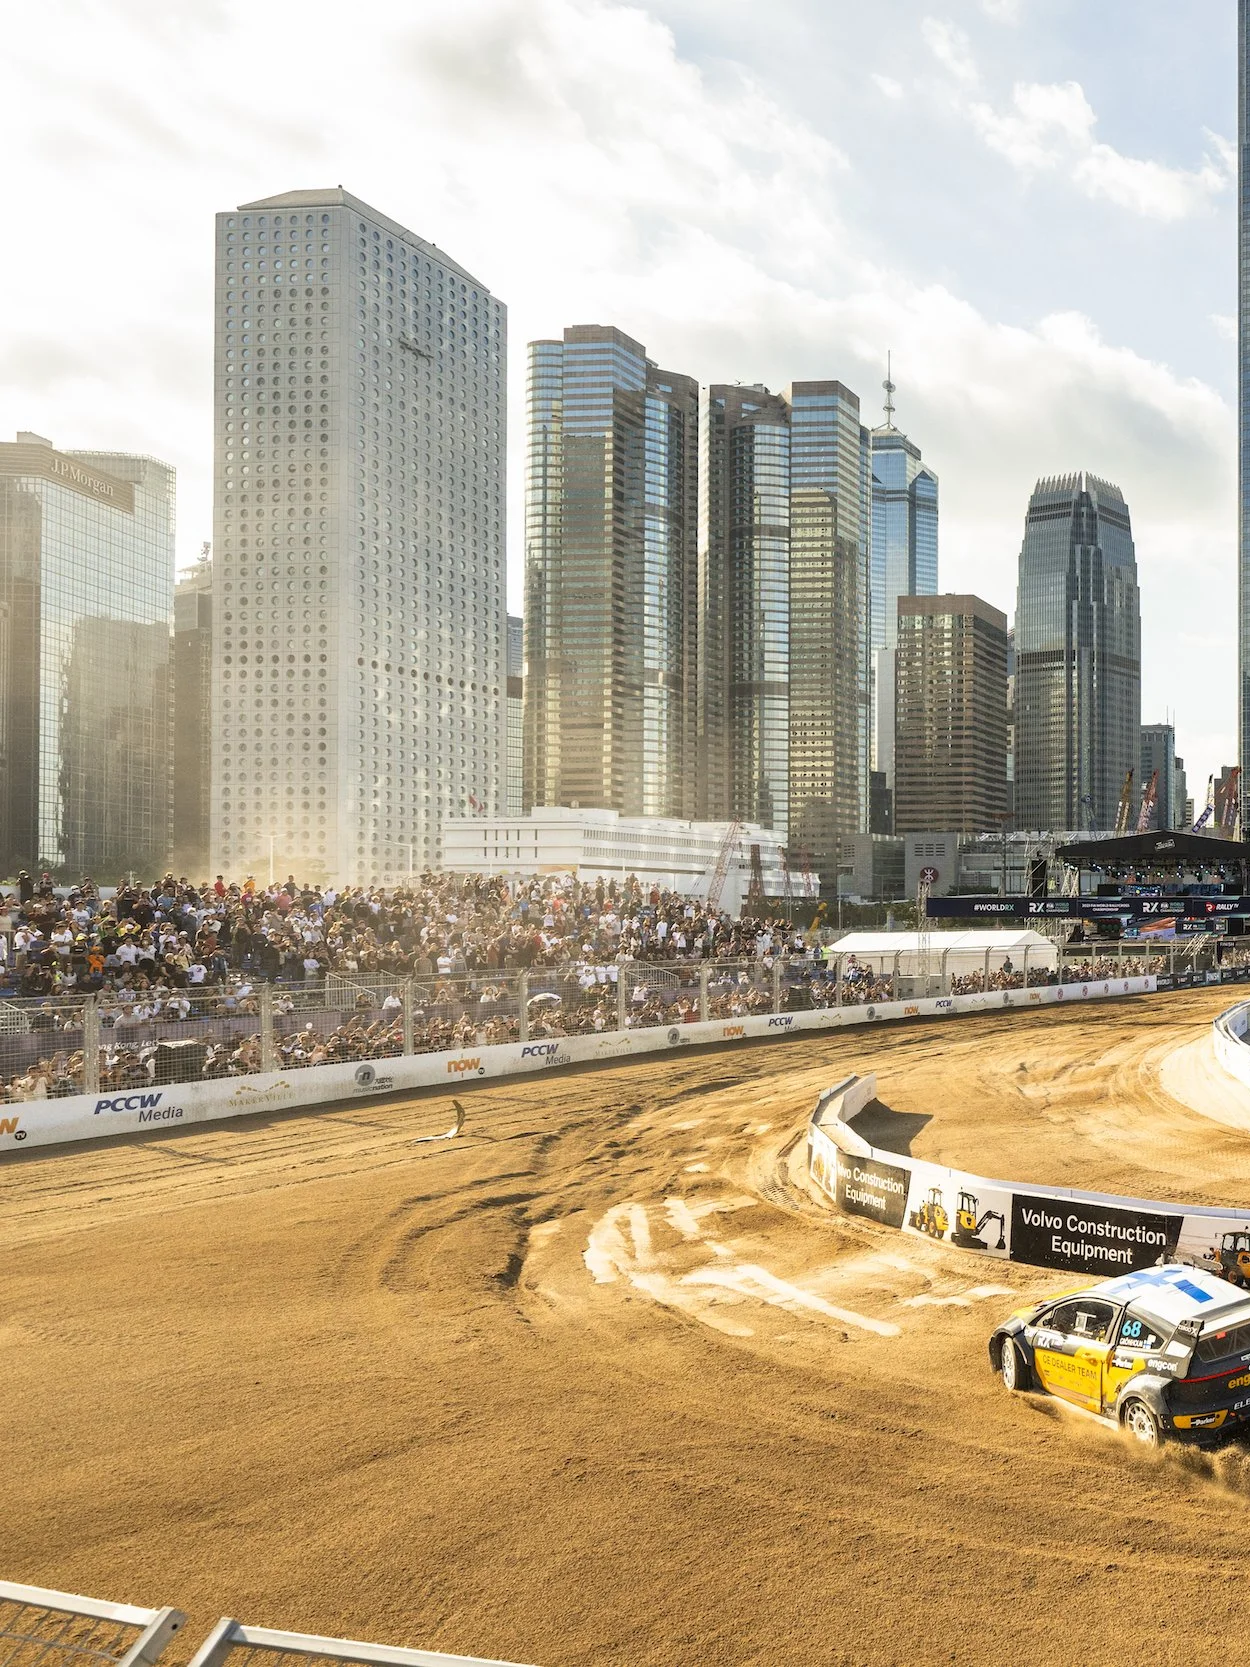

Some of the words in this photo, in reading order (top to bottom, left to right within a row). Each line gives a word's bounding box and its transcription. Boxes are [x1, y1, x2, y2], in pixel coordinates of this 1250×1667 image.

[51, 458, 114, 497] J.P.Morgan
[974, 903, 1014, 912] #WORLDRX
[1029, 902, 1045, 913] RX
[1143, 902, 1159, 913] RX
[1216, 903, 1233, 911] RALLY
[768, 1016, 793, 1027] PCCW
[723, 1025, 744, 1037] now
[521, 1044, 559, 1057] PCCW
[447, 1058, 480, 1073] now
[545, 1054, 571, 1065] Media
[94, 1092, 163, 1115] PCCW
[138, 1106, 183, 1123] Media
[16, 1131, 26, 1139] TV
[853, 1167, 905, 1195] Construction
[845, 1185, 886, 1211] Equipment
[1021, 1208, 1063, 1230] Volvo
[1066, 1214, 1167, 1246] Construction
[1052, 1235, 1133, 1265] Equipment
[1122, 1320, 1142, 1337] 68
[1043, 1354, 1051, 1365] CE
[1052, 1358, 1076, 1373] DEALER
[1078, 1366, 1097, 1380] TEAM
[1147, 1358, 1177, 1372] engcon
[1195, 1415, 1215, 1426] Parker
